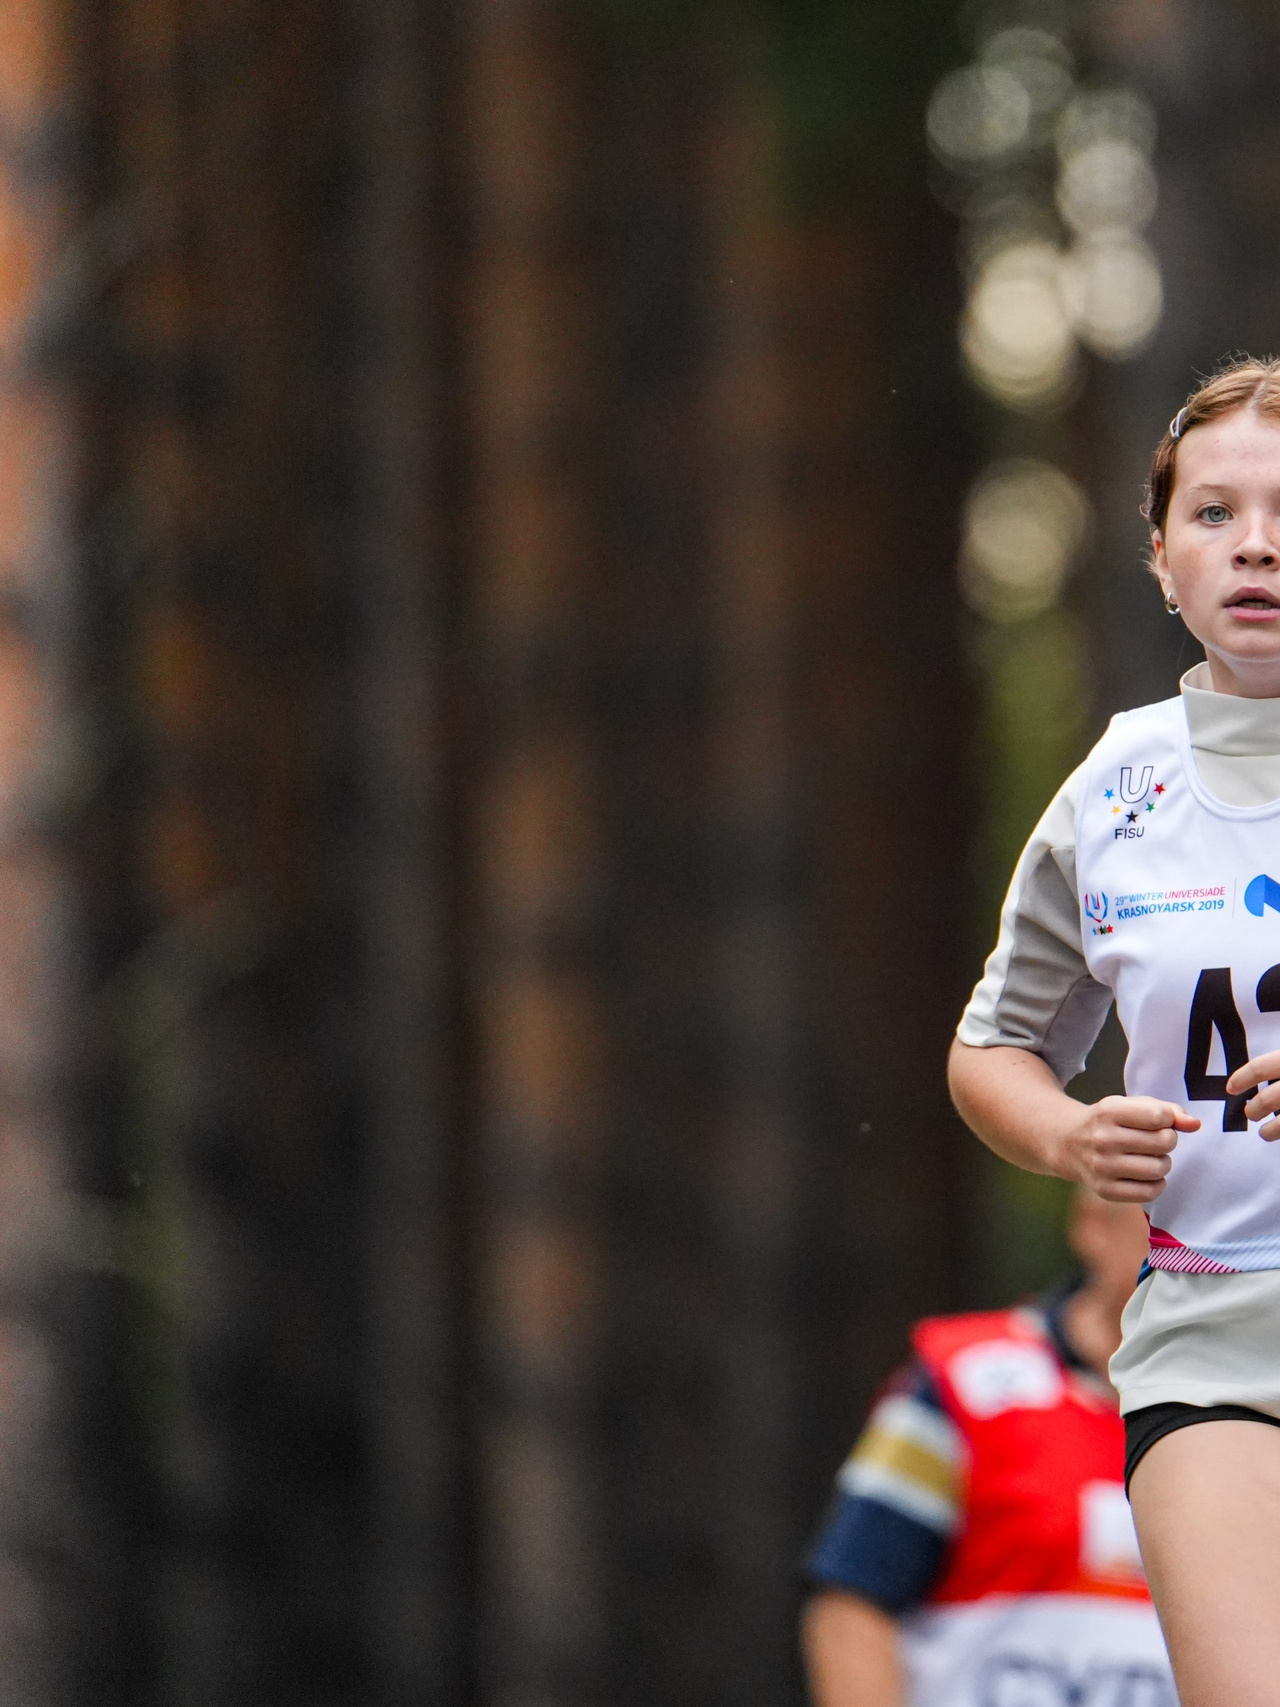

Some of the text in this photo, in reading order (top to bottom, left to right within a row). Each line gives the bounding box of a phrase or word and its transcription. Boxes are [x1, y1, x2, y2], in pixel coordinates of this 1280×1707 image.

[1114, 826, 1145, 840] FISU
[1129, 891, 1163, 903] WINTER
[1164, 886, 1227, 900] UNIVERSIADE
[1117, 899, 1225, 921] KRASNOYARSK 2019
